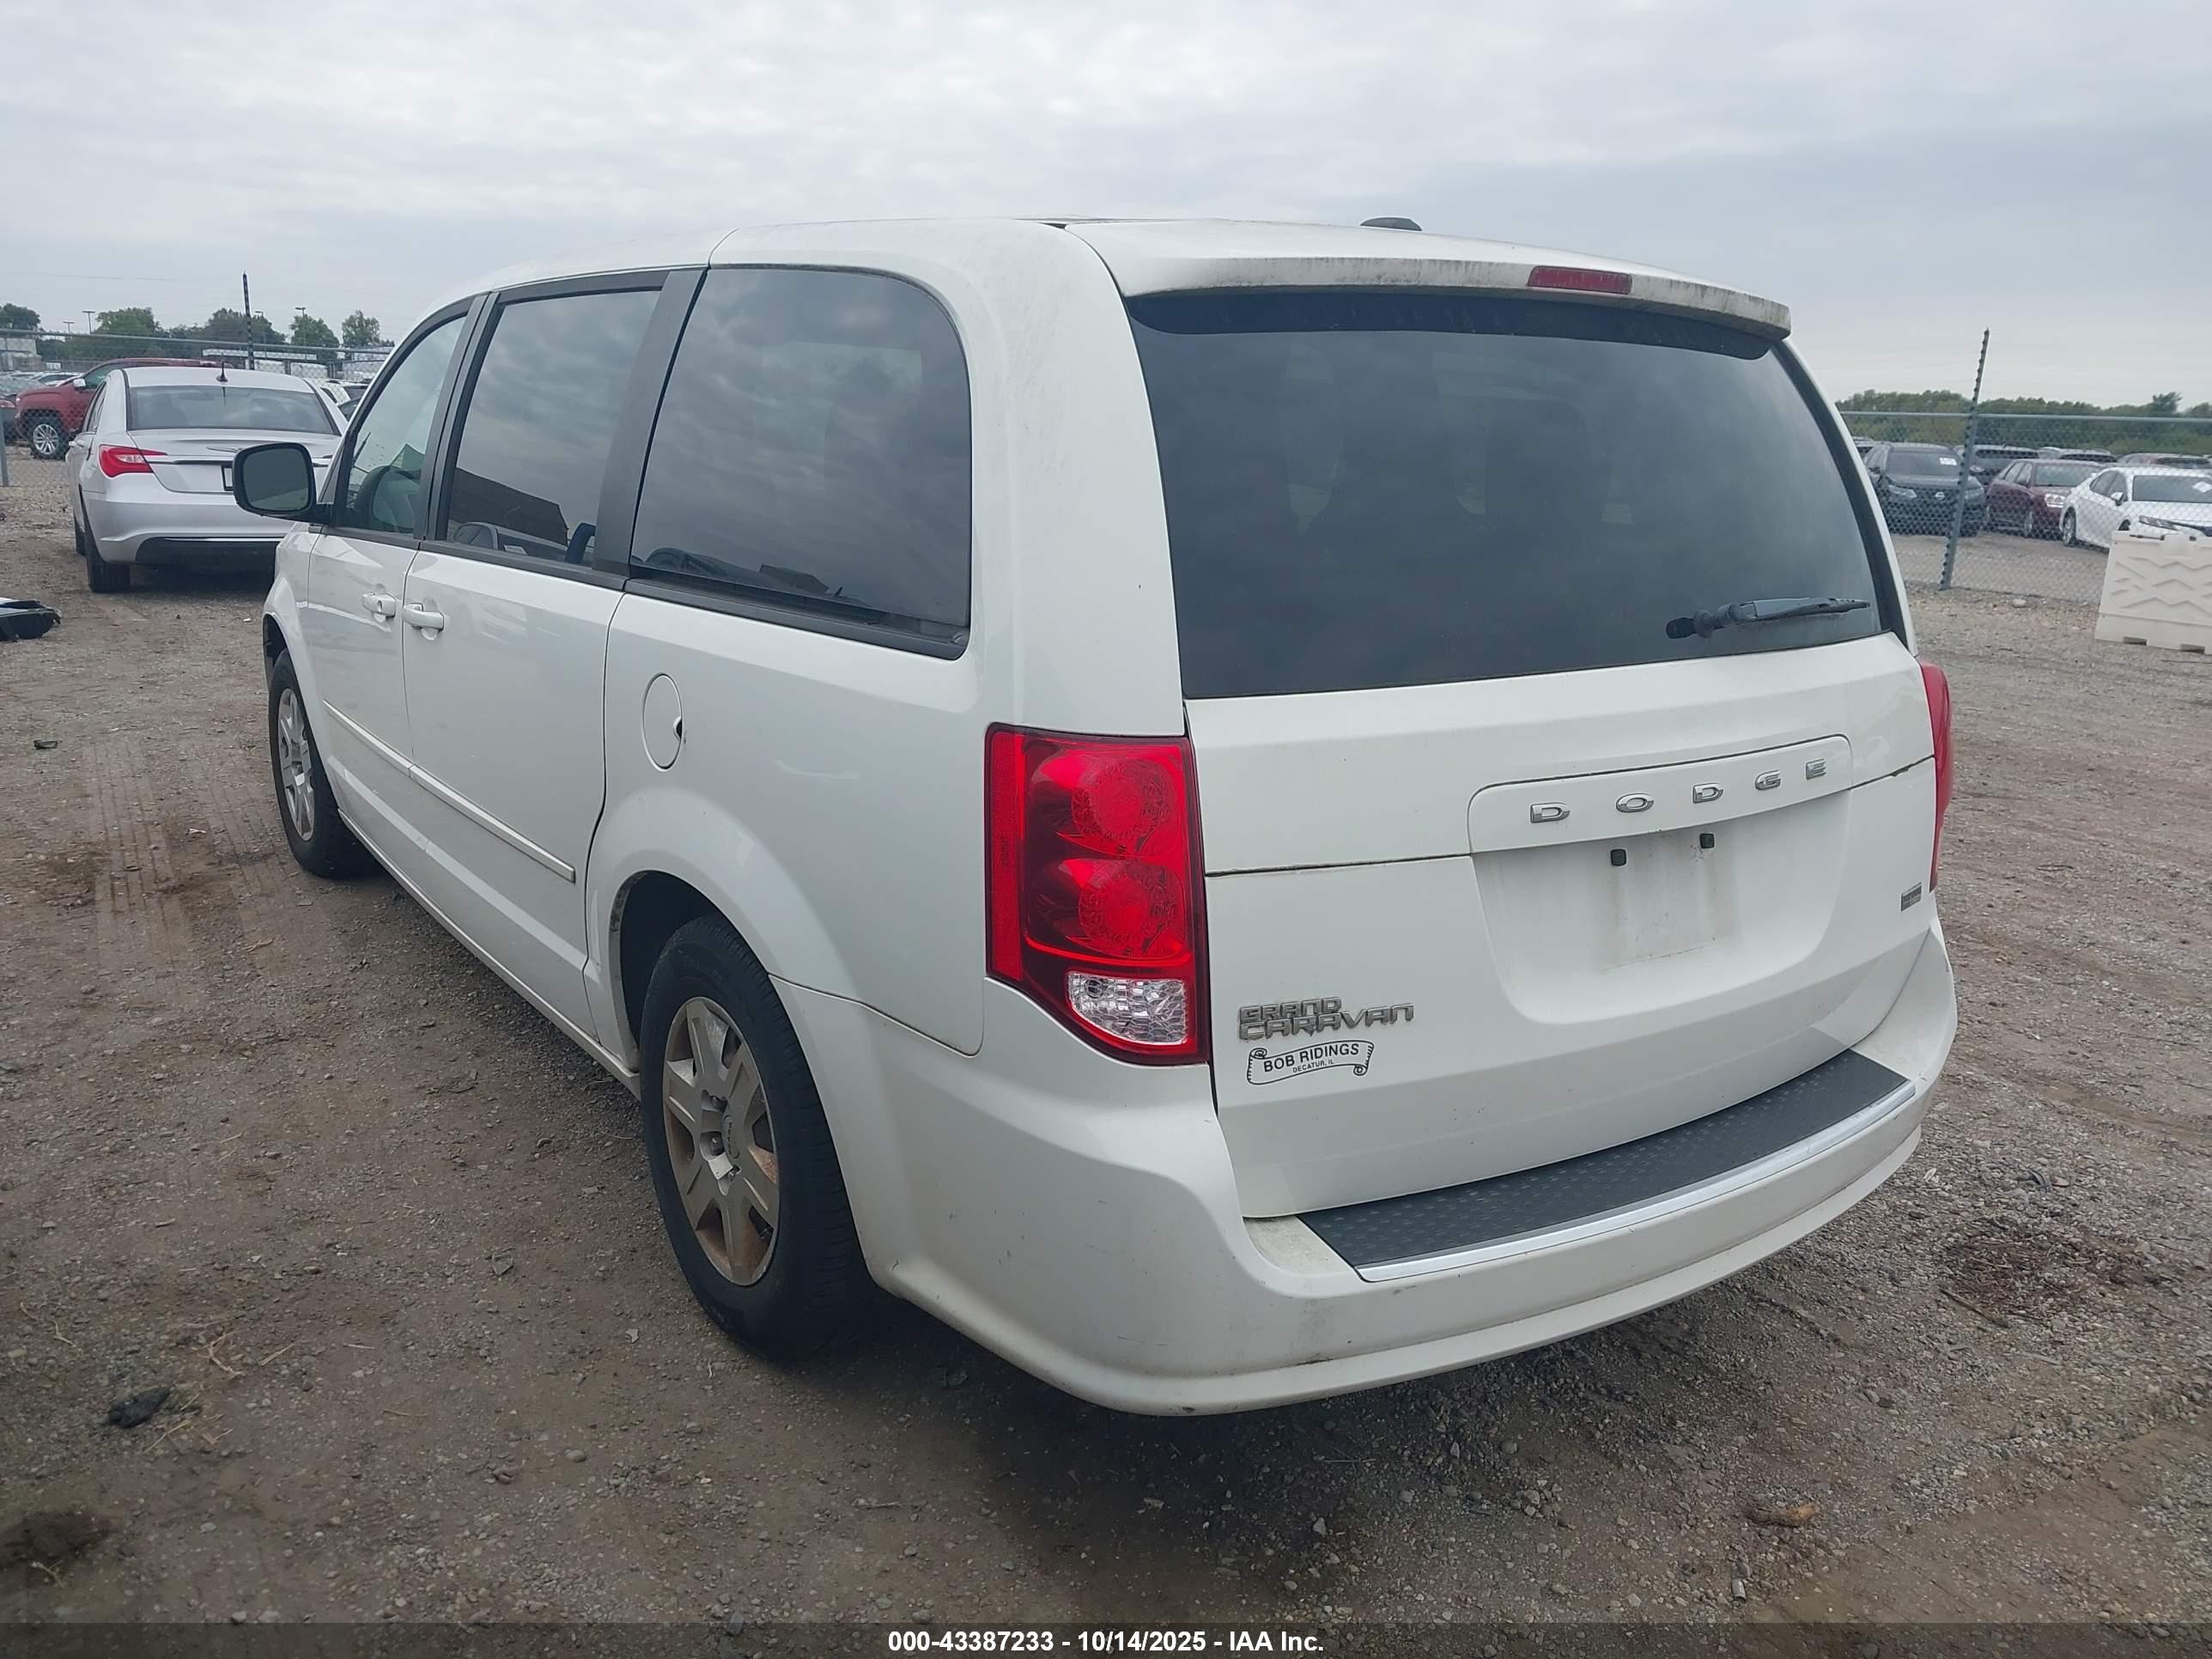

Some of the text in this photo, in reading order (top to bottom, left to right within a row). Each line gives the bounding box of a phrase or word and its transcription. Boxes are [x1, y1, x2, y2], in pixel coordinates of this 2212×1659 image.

[1530, 758, 1827, 823] DODGE
[1239, 997, 1342, 1024] GRAND
[1239, 1002, 1415, 1041] CARAVAN
[1263, 1043, 1359, 1073] BOB RIDINGS
